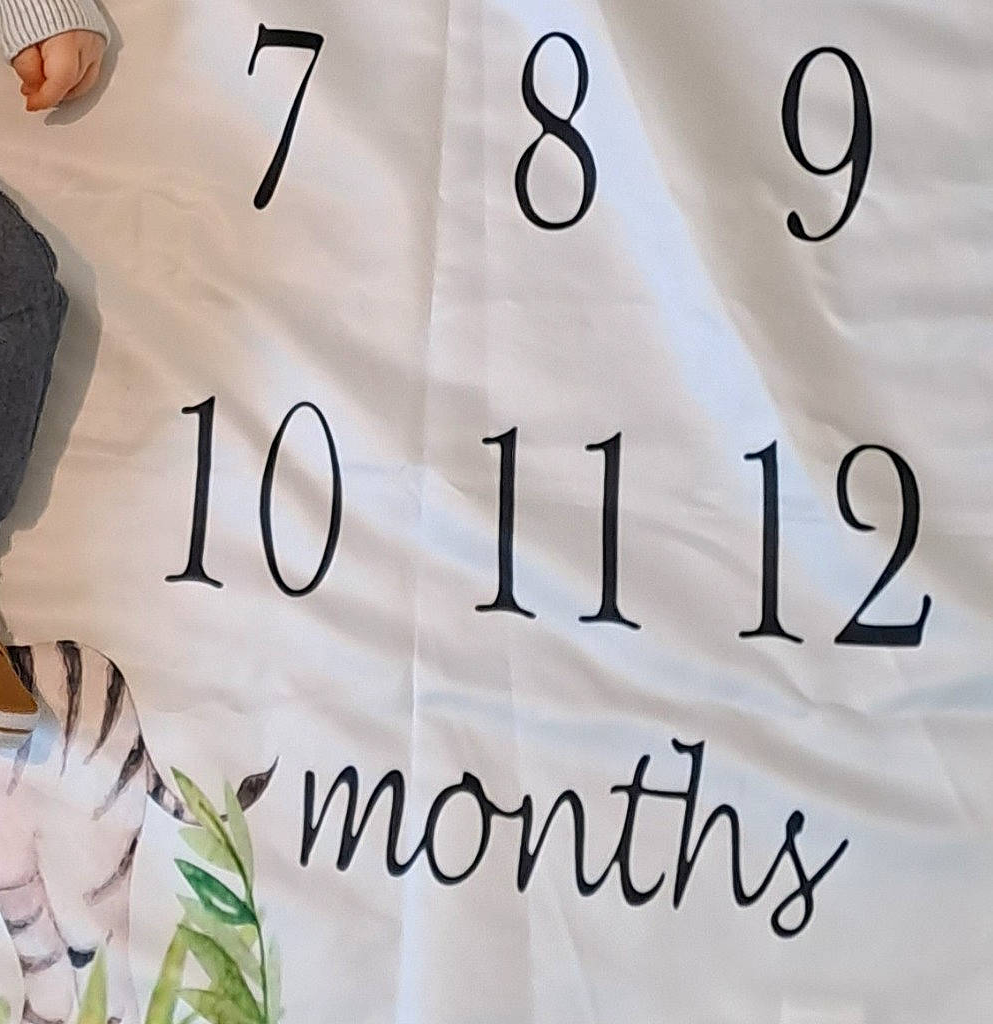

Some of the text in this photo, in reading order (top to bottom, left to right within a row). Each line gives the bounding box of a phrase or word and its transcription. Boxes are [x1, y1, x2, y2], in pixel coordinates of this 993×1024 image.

[247, 22, 874, 243] 7 8 9
[165, 395, 933, 647] 10 11 12
[299, 737, 850, 938] months
